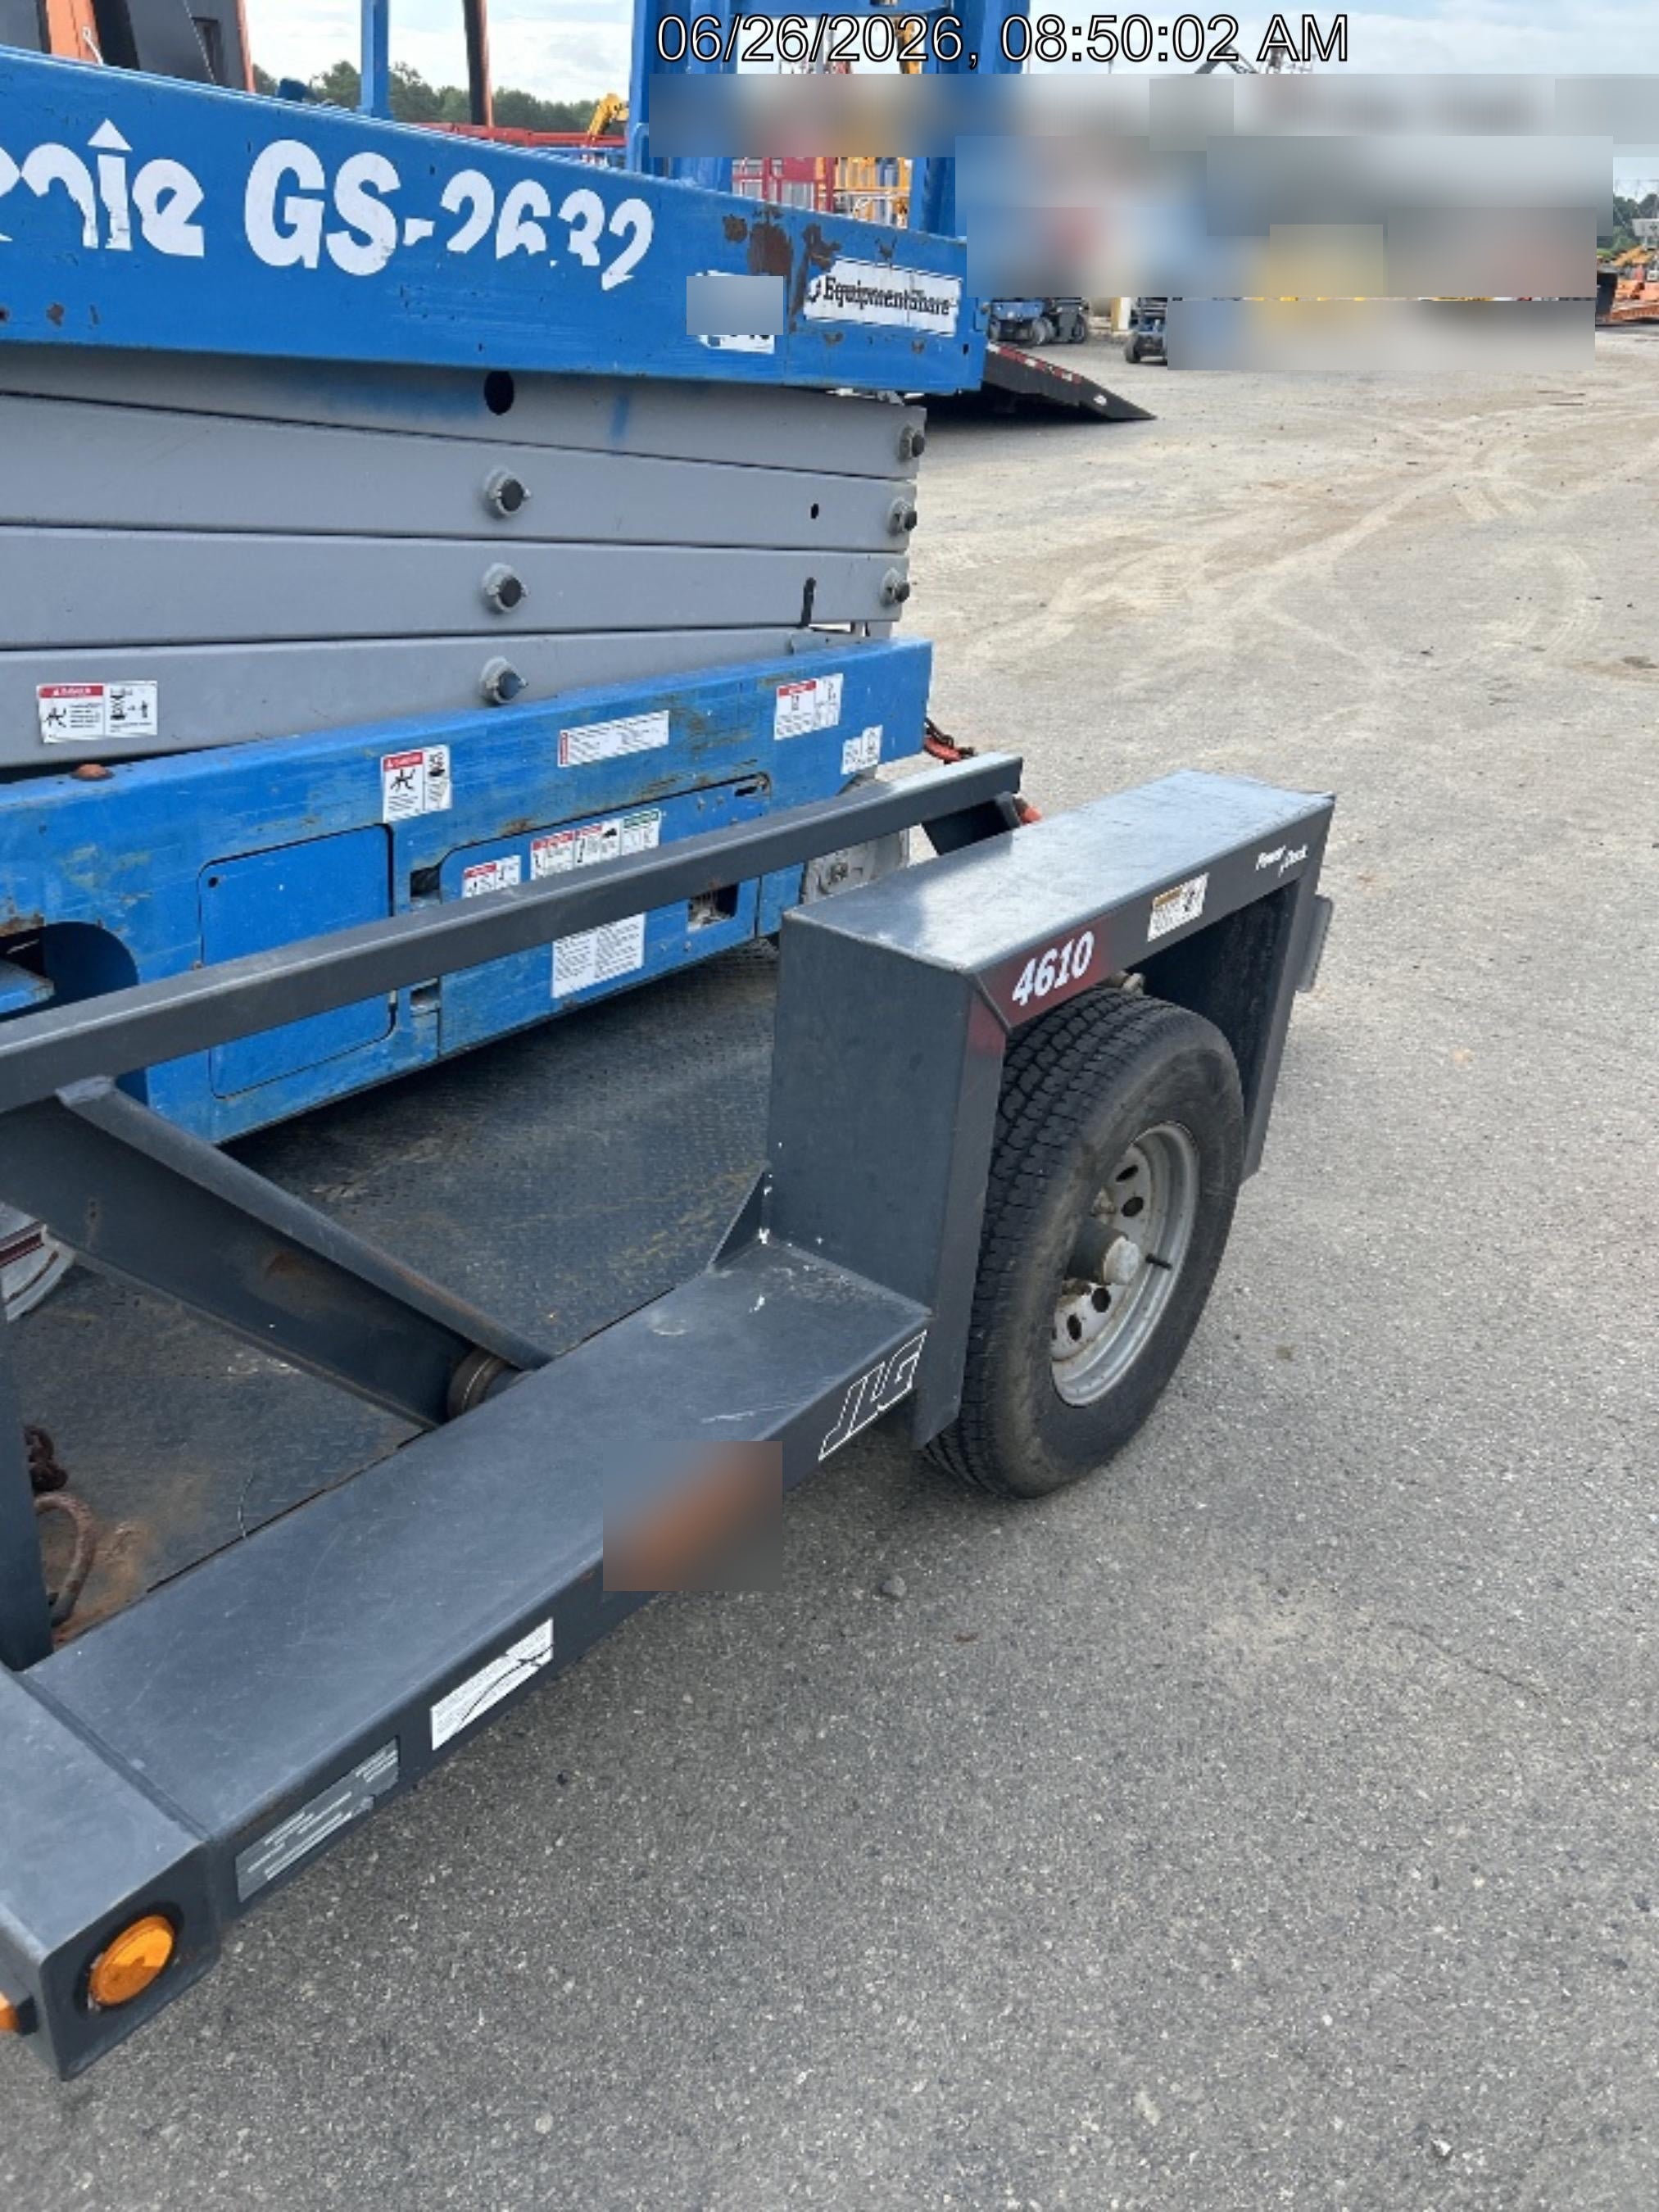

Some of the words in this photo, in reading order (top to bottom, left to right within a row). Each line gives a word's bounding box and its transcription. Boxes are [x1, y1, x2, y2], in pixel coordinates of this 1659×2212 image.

[244, 138, 655, 292] GS-2632
[1012, 931, 1095, 1007] 4610
[818, 1328, 928, 1462] JLG
